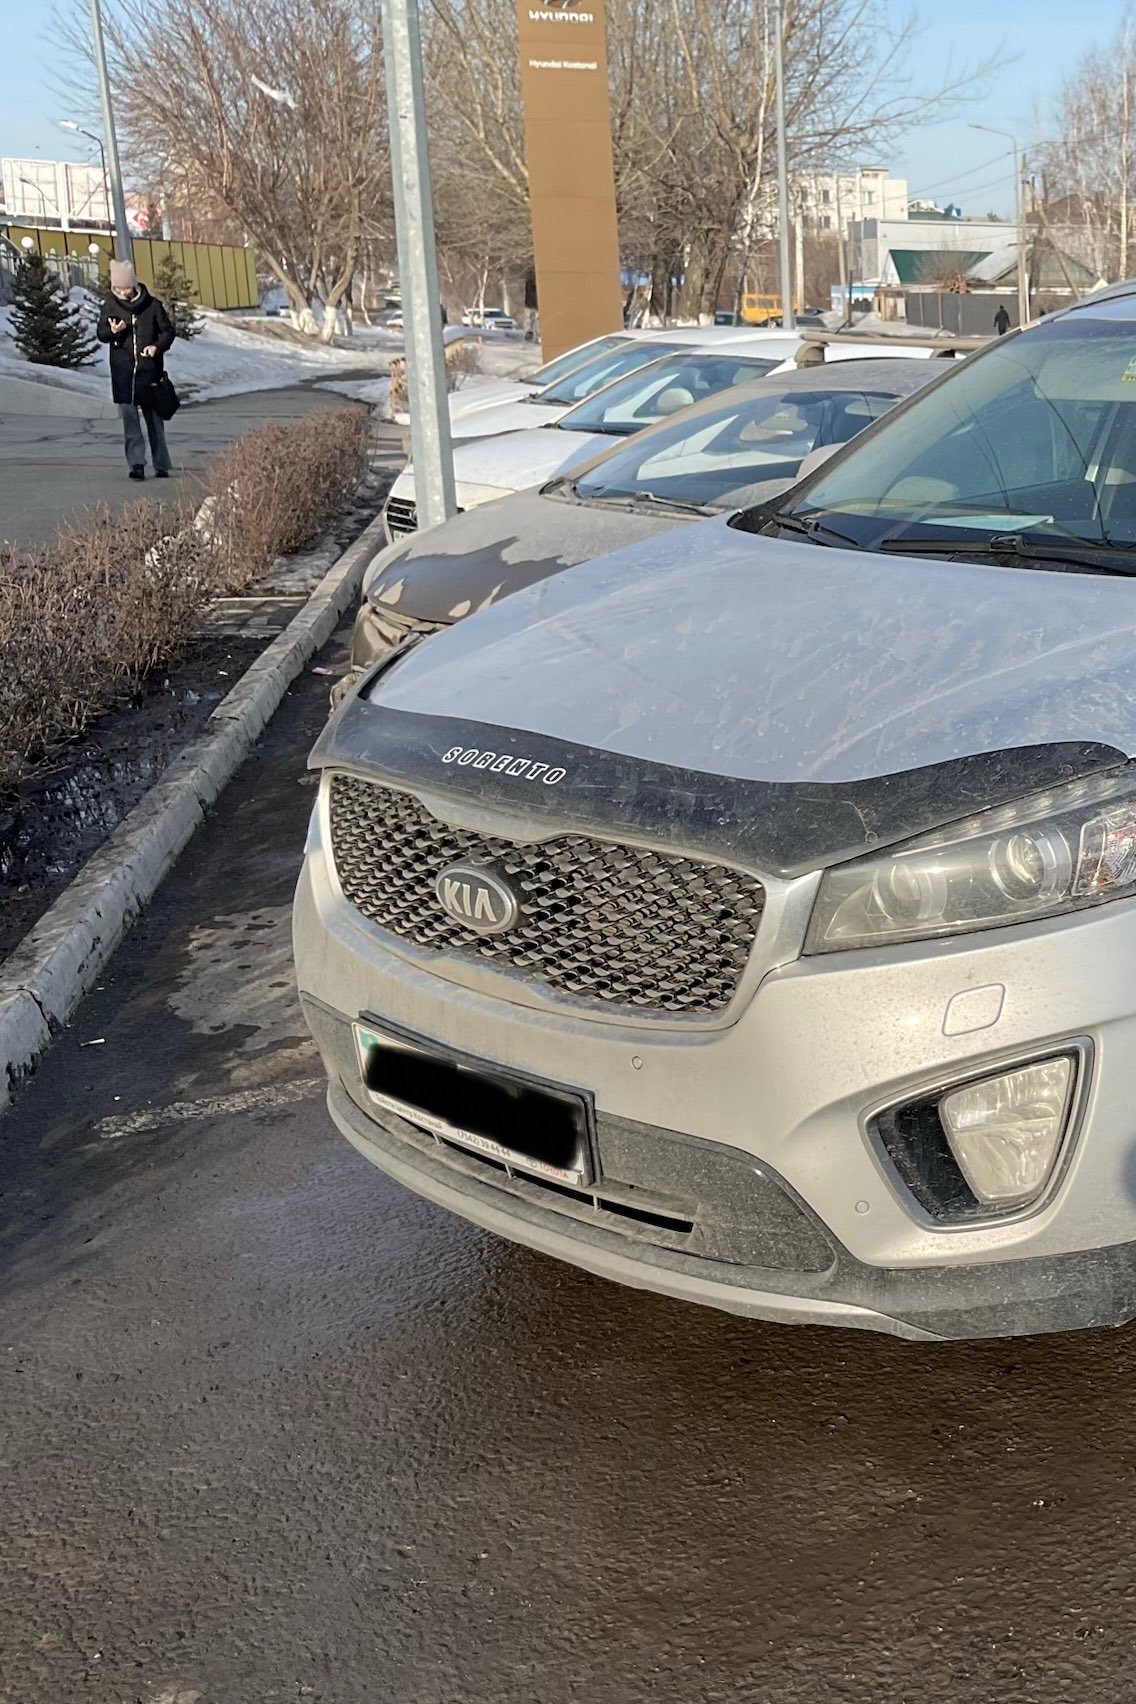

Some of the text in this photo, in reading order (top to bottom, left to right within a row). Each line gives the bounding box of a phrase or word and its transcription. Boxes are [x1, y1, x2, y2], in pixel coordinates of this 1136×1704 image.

[529, 59, 561, 69] Hyundai
[442, 746, 566, 785] SORENTO
[444, 877, 497, 922] KIA
[539, 1161, 569, 1179] TOYOTA
